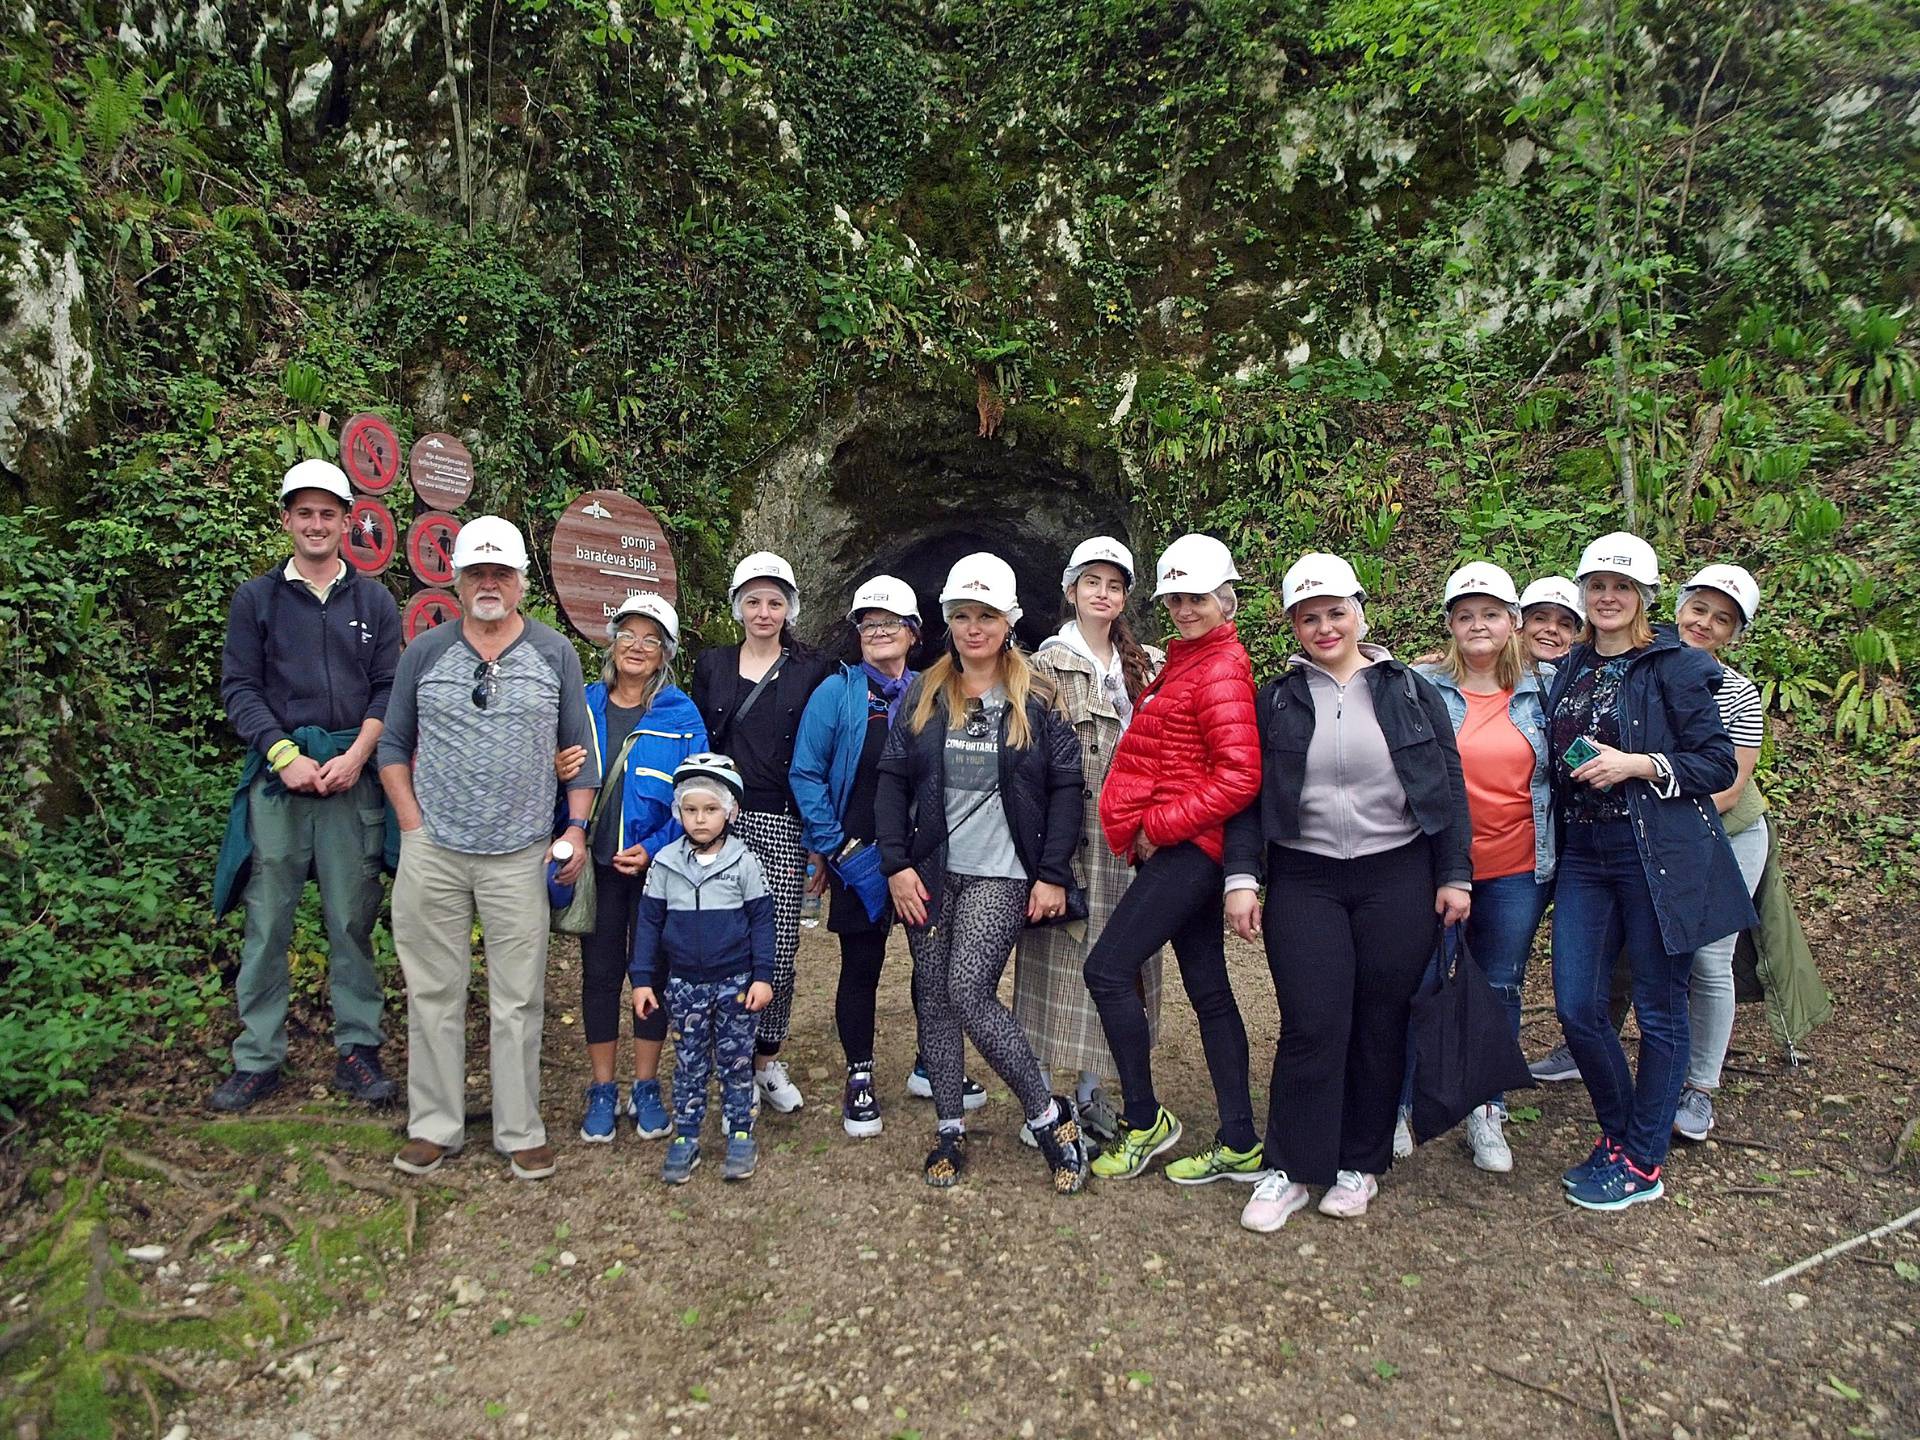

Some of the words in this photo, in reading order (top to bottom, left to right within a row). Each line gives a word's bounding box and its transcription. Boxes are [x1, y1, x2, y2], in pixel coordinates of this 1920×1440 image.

[621, 535, 656, 553] gornja
[576, 545, 627, 566] baraćeva
[628, 554, 657, 573] špilja
